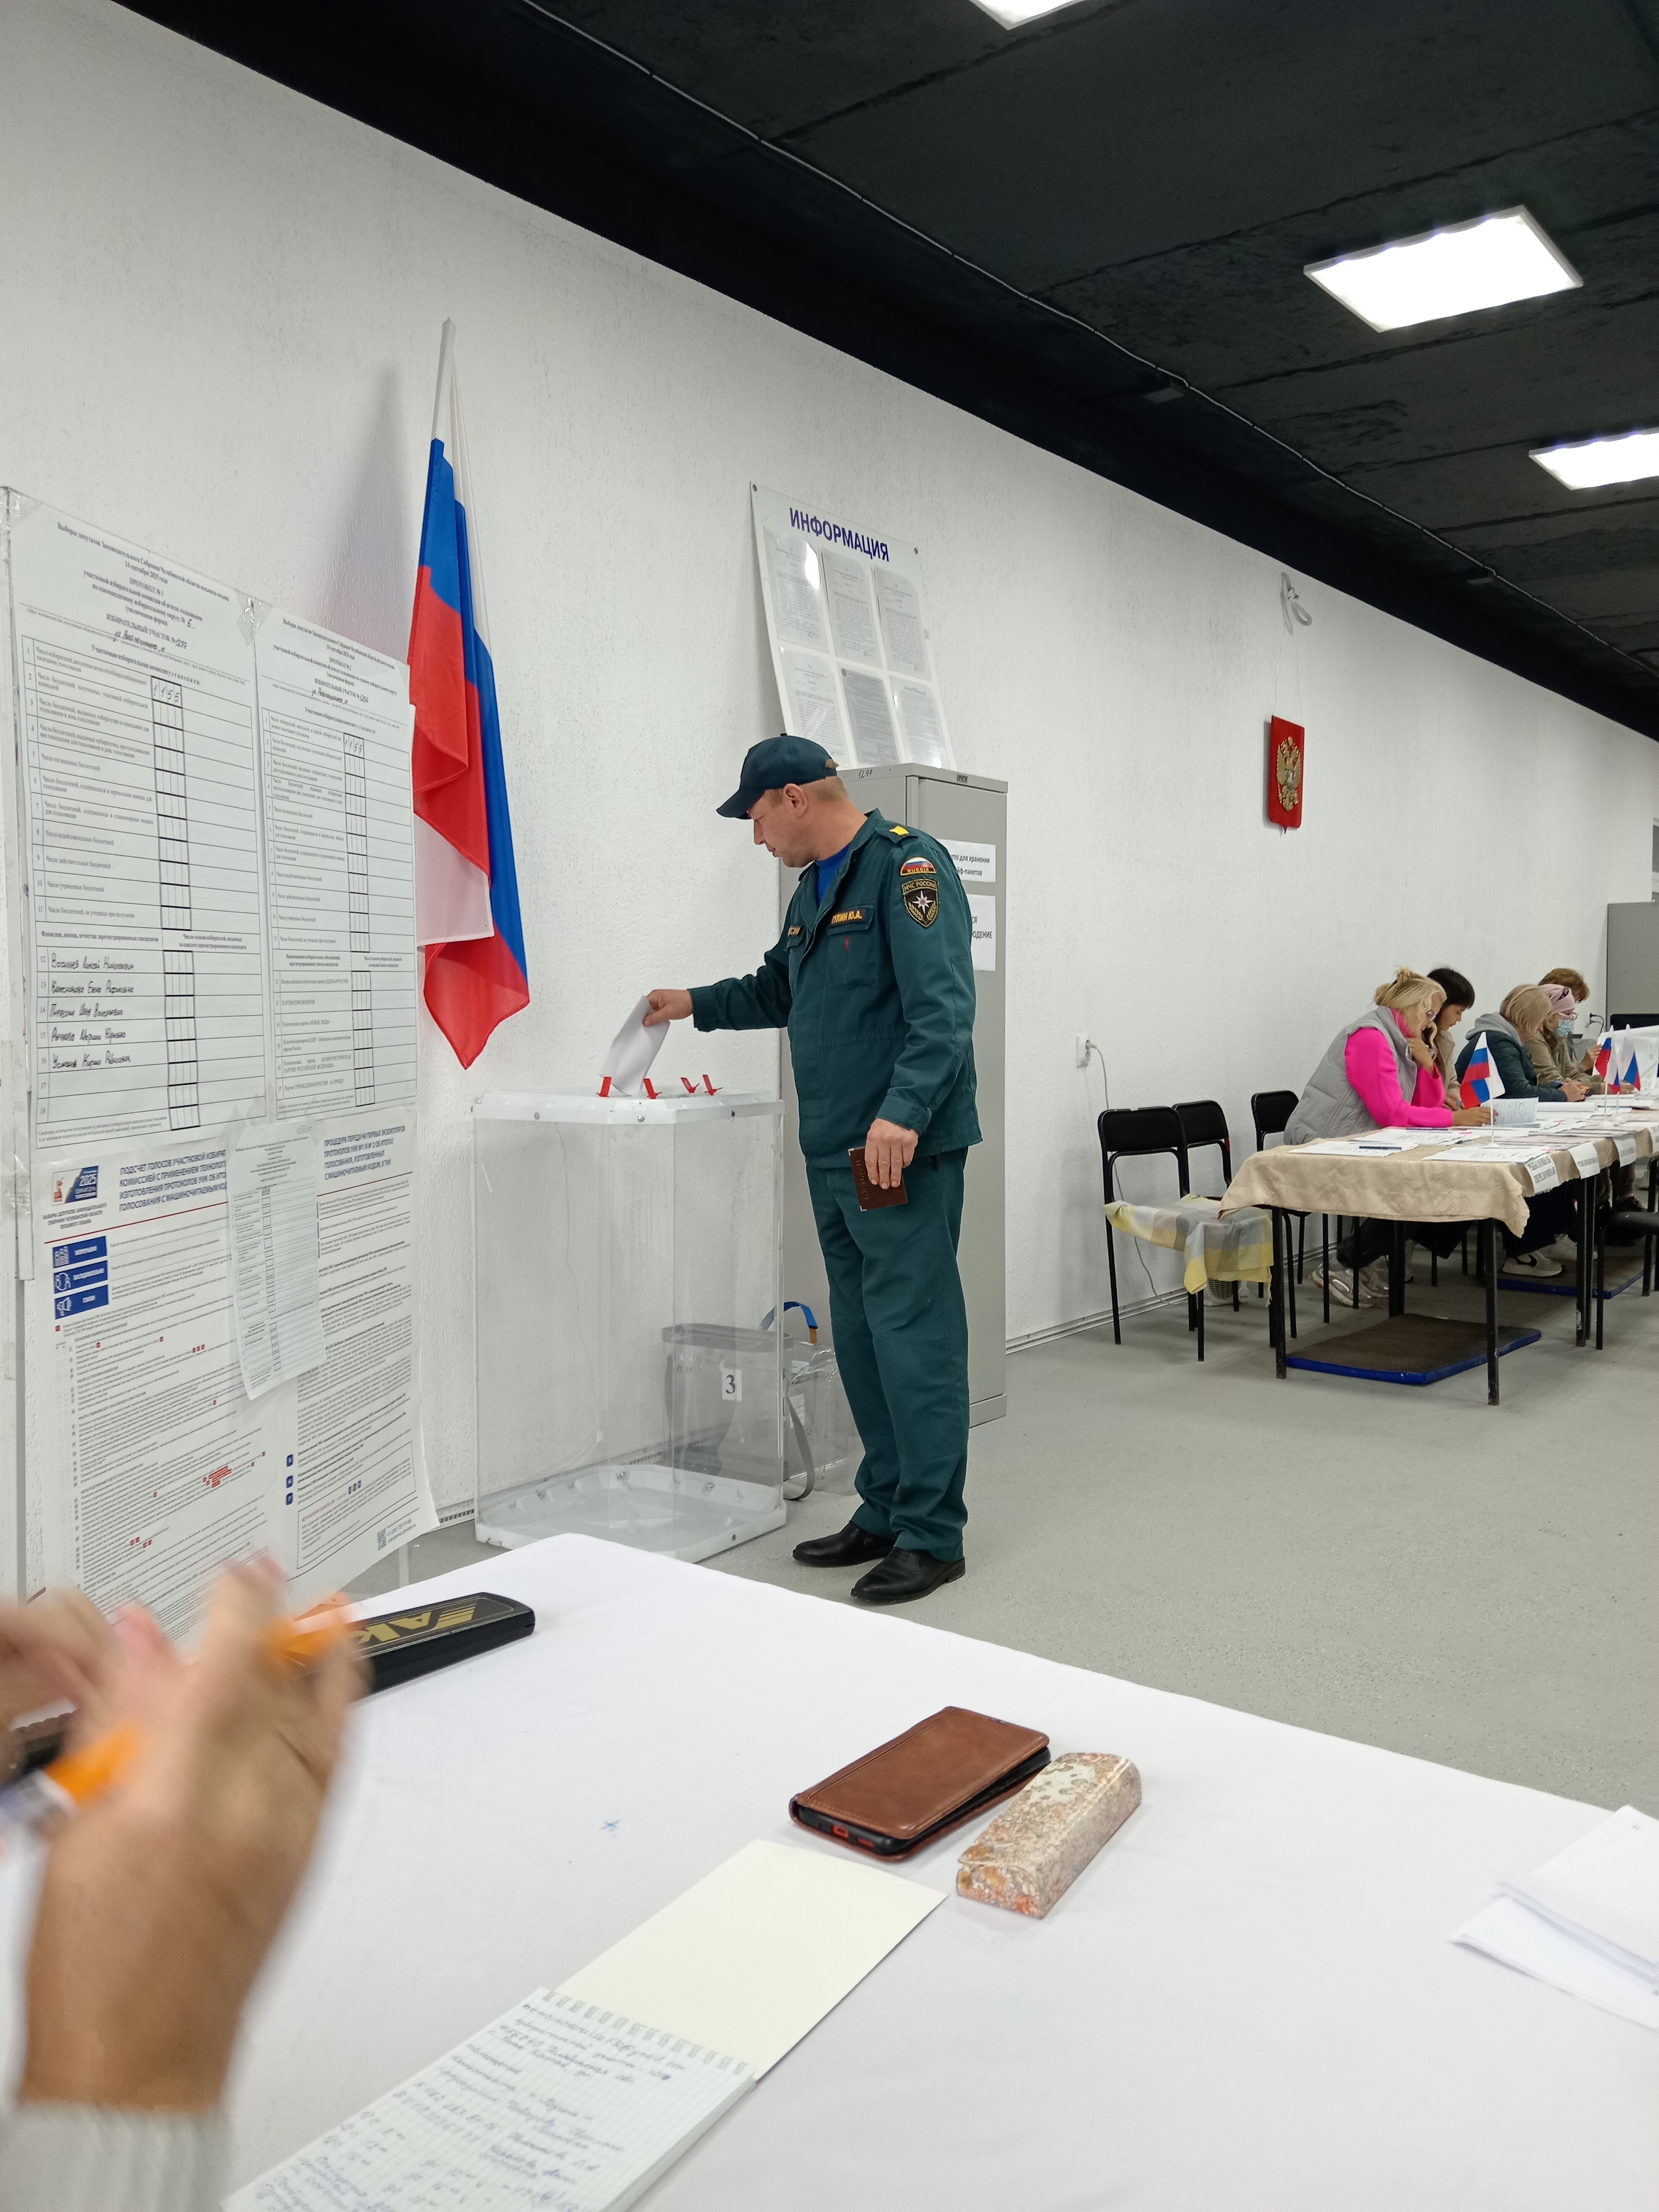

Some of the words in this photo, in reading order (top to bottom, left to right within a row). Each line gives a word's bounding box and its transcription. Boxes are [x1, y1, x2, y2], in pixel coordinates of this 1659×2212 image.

[789, 507, 890, 562] ИНФОРМАЦИЯ
[125, 560, 129, 568] 14
[28, 673, 32, 681] 2
[31, 724, 34, 732] 4
[858, 768, 873, 779] 1297
[33, 776, 37, 784] 6
[903, 882, 915, 892] МЧС
[847, 910, 863, 921] Ю.А.
[120, 1163, 147, 1176] ПОДСЧЕТ
[148, 1159, 172, 1170] ГОЛОСОВ
[79, 1172, 97, 1187] 2025
[119, 1195, 161, 1212] ГОЛОСОВАНИЯ
[725, 1374, 736, 1394] 3
